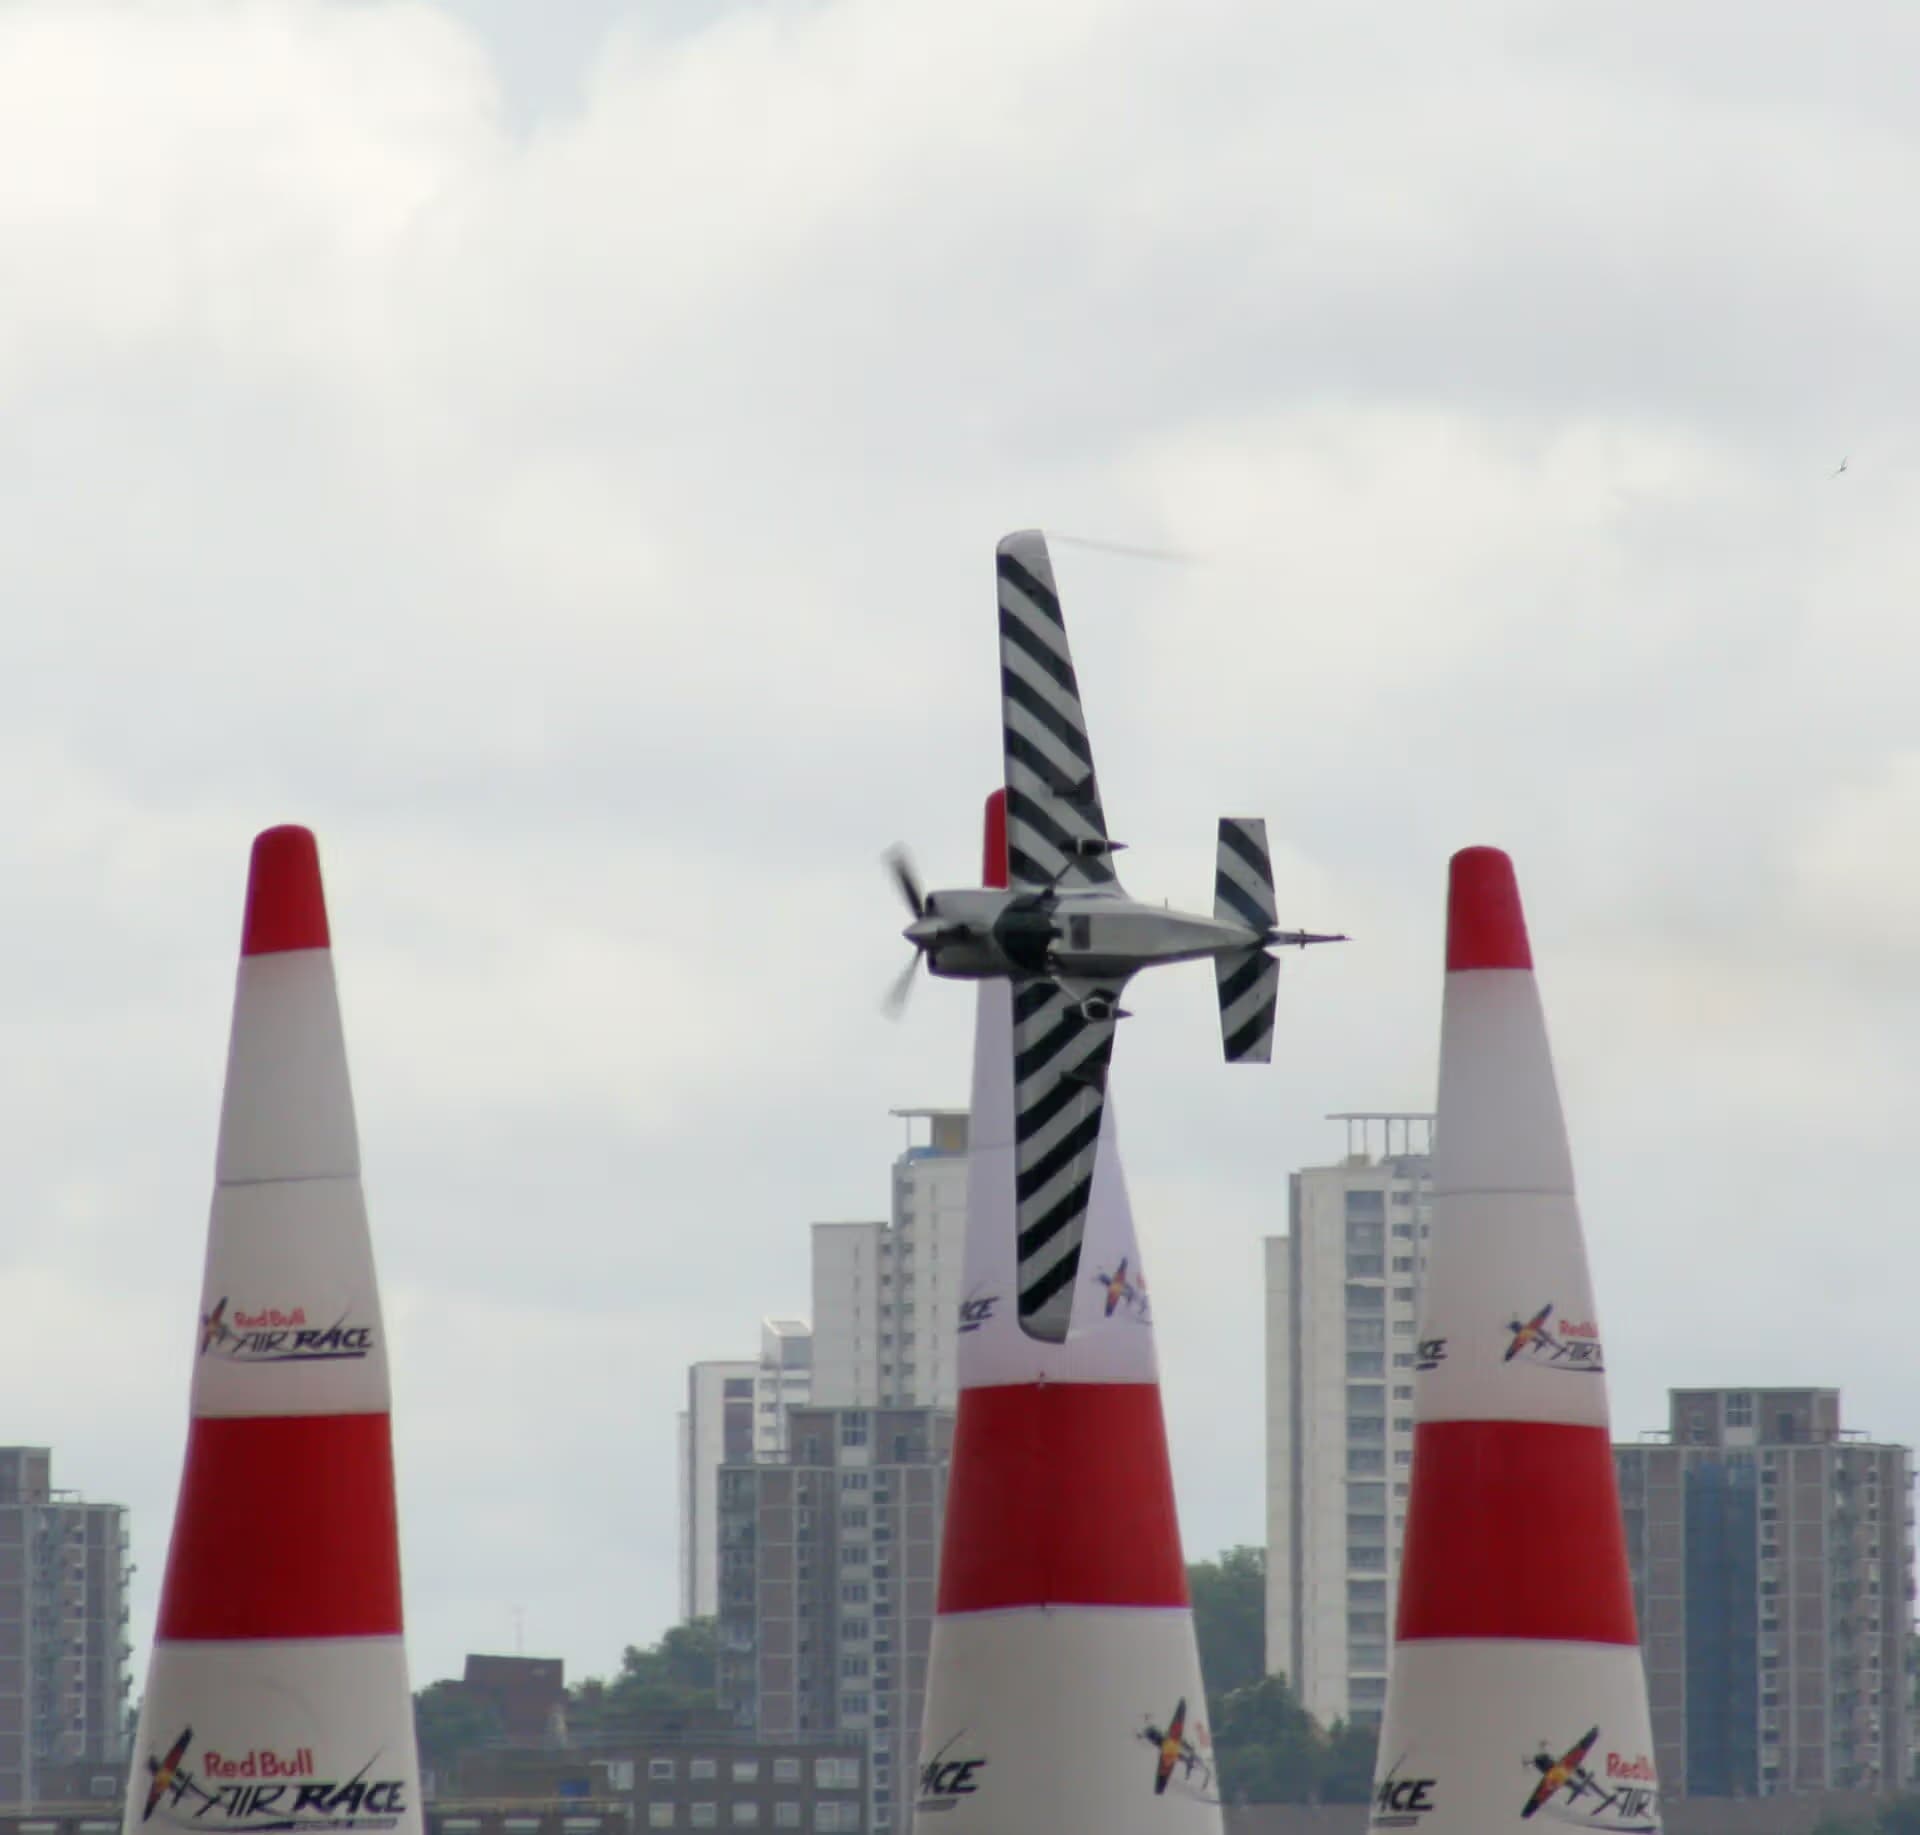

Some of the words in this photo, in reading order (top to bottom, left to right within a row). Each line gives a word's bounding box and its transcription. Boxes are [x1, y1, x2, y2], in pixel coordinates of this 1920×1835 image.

[233, 1309, 267, 1328] Red
[269, 1307, 306, 1327] Bull
[232, 1330, 289, 1352] AIR
[294, 1321, 373, 1350] RACE
[204, 1751, 254, 1777] Red
[260, 1748, 313, 1777] Bull
[194, 1784, 286, 1817] AIR
[292, 1768, 406, 1814] RACE
